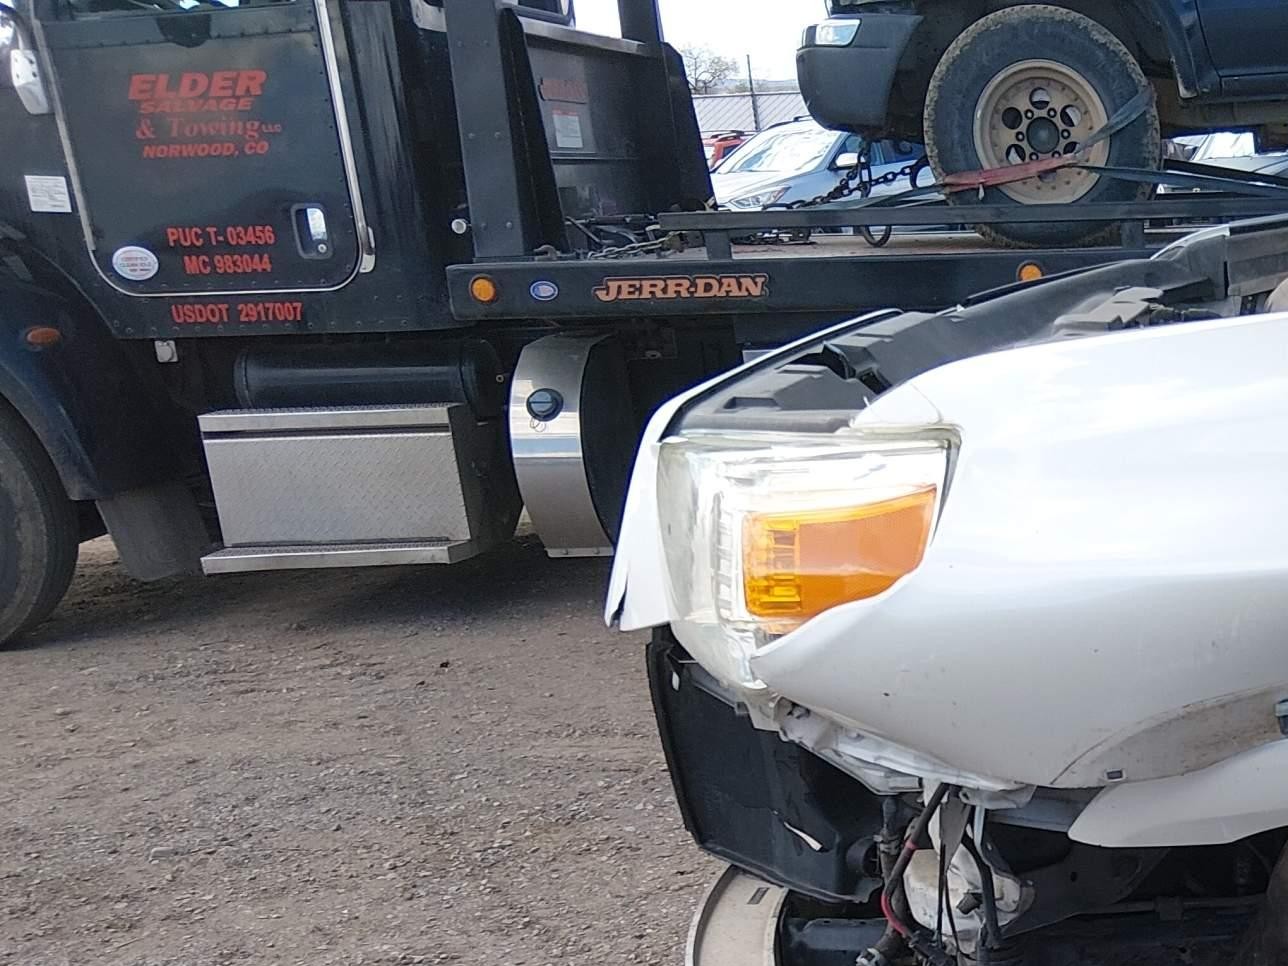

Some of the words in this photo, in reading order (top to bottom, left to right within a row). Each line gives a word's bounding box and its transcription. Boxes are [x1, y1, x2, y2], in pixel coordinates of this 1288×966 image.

[128, 70, 267, 100] ELDER
[139, 97, 256, 114] SALVAGE
[135, 118, 155, 139] &
[168, 116, 260, 140] Towing
[143, 143, 239, 159] NORWOOD,
[244, 141, 270, 155] CO
[167, 227, 204, 247] PUC
[227, 226, 275, 246] 03456
[183, 255, 211, 274] MC
[214, 254, 272, 274] 983044
[595, 276, 767, 301] JERR-DAN
[171, 303, 229, 323] USDOT
[237, 302, 302, 322] 2917007
